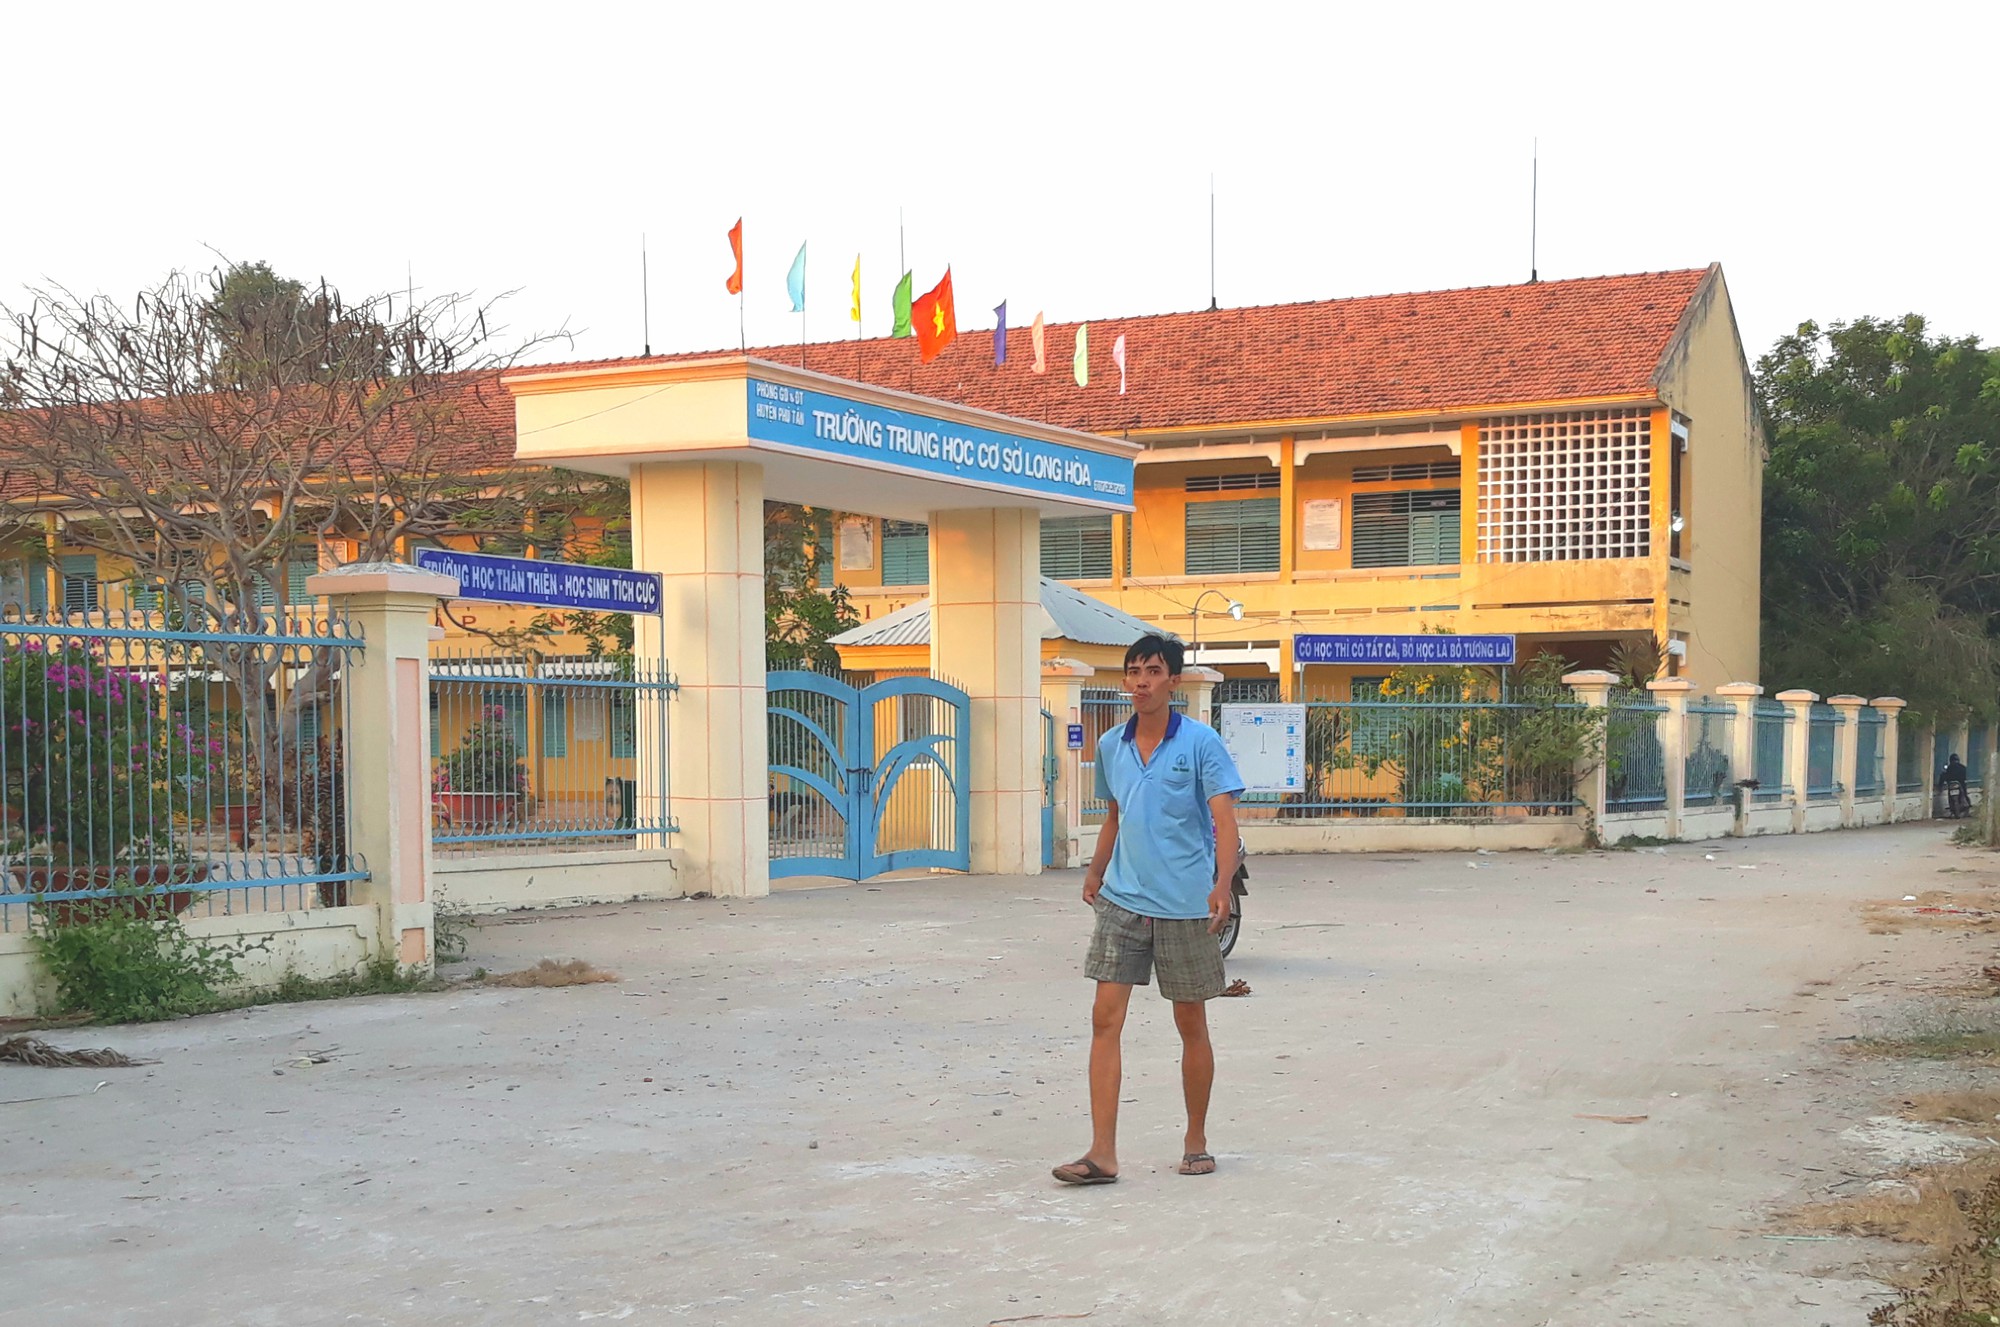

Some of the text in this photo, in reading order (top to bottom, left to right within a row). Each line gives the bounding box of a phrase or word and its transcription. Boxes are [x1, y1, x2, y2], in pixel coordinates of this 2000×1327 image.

[756, 382, 778, 400] PHÒNG
[756, 402, 777, 423] HUYỆN
[812, 408, 1092, 487] TRƯỜNG TRUNG HỌC CƠ SỞ LONG HÒA
[472, 565, 494, 597] HỌC
[496, 564, 525, 593] THÂN
[526, 567, 558, 601] THIỆN
[565, 574, 585, 605] HỌC
[586, 576, 610, 600] SINH
[612, 574, 634, 602] TÍCH
[635, 578, 656, 610] CỰC
[1299, 636, 1510, 662] CÓ HỌC THÌ CÓ TẤT CẢ, BỎ HỌC LÀ BỎ TƯƠNG LAI
